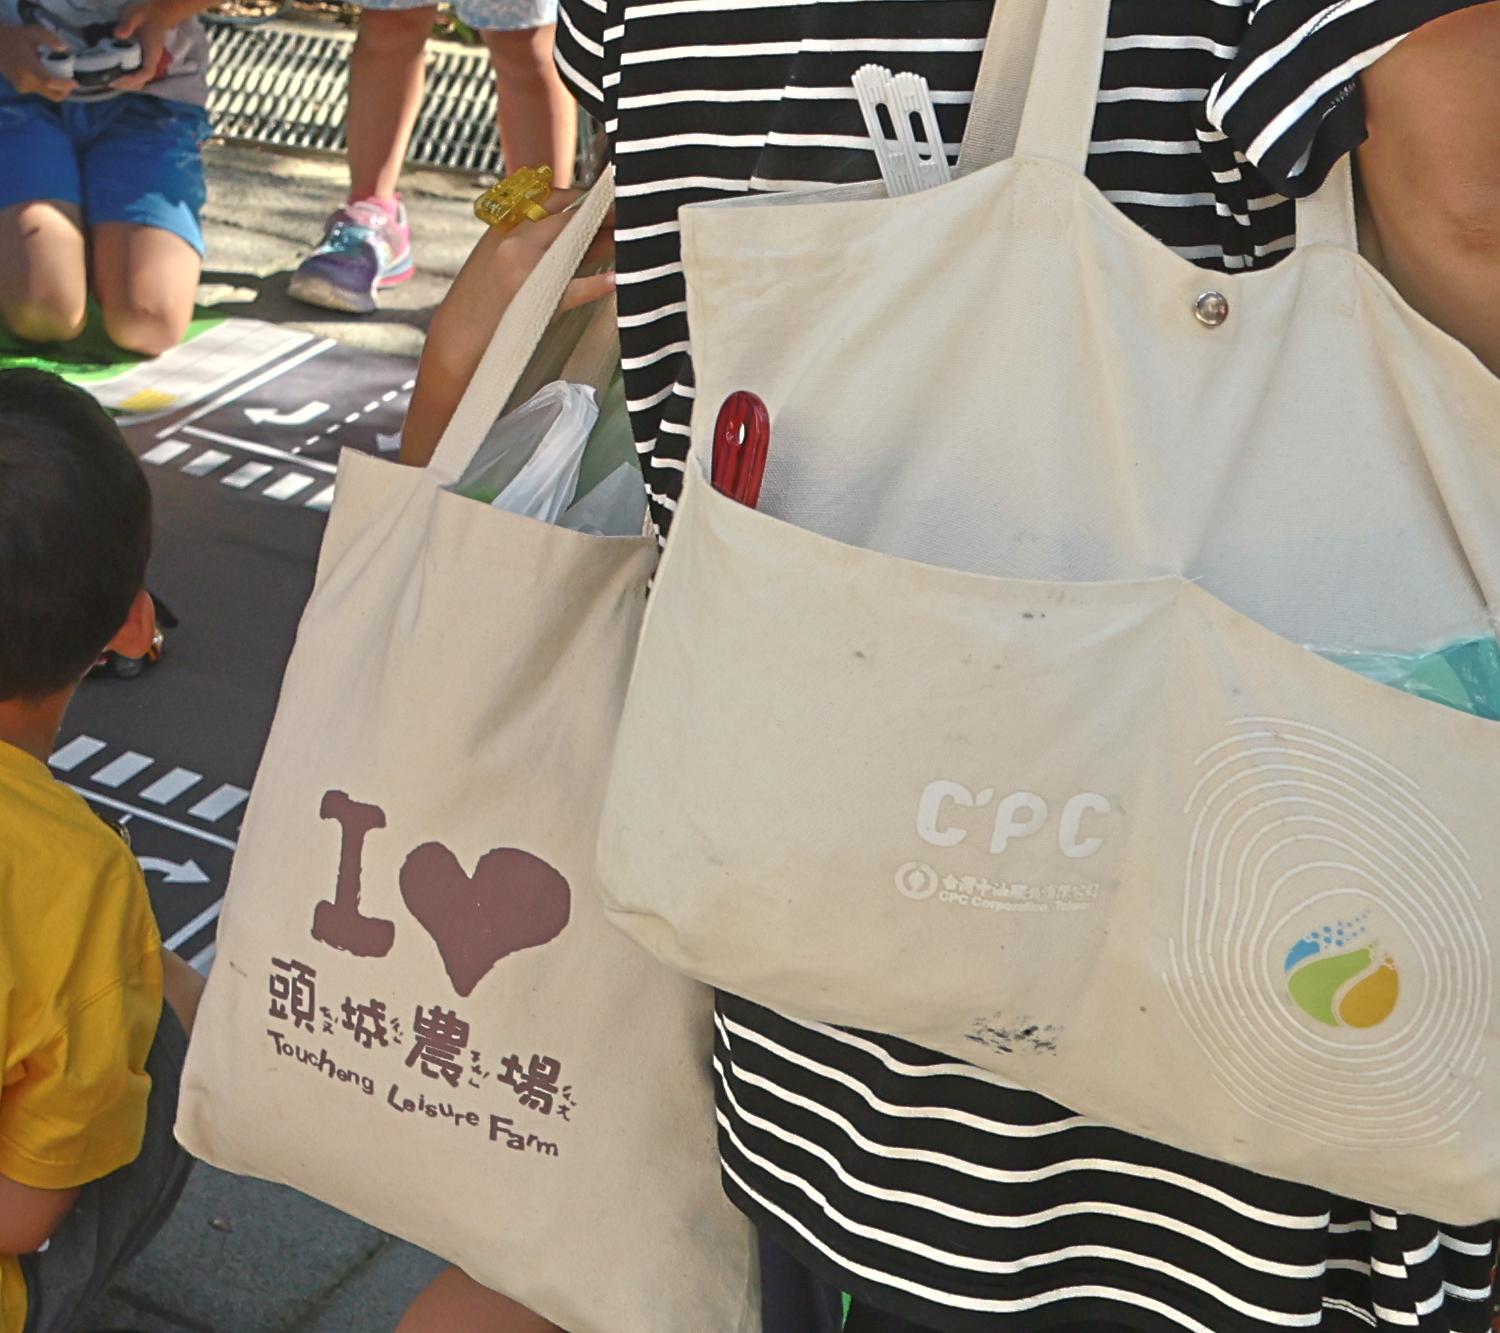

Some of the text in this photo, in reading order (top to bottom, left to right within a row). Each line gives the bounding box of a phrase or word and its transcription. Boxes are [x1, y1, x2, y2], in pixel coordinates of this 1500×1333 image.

[310, 789, 396, 957] I
[266, 1029, 559, 1157] Toucheng Leisure Farm
